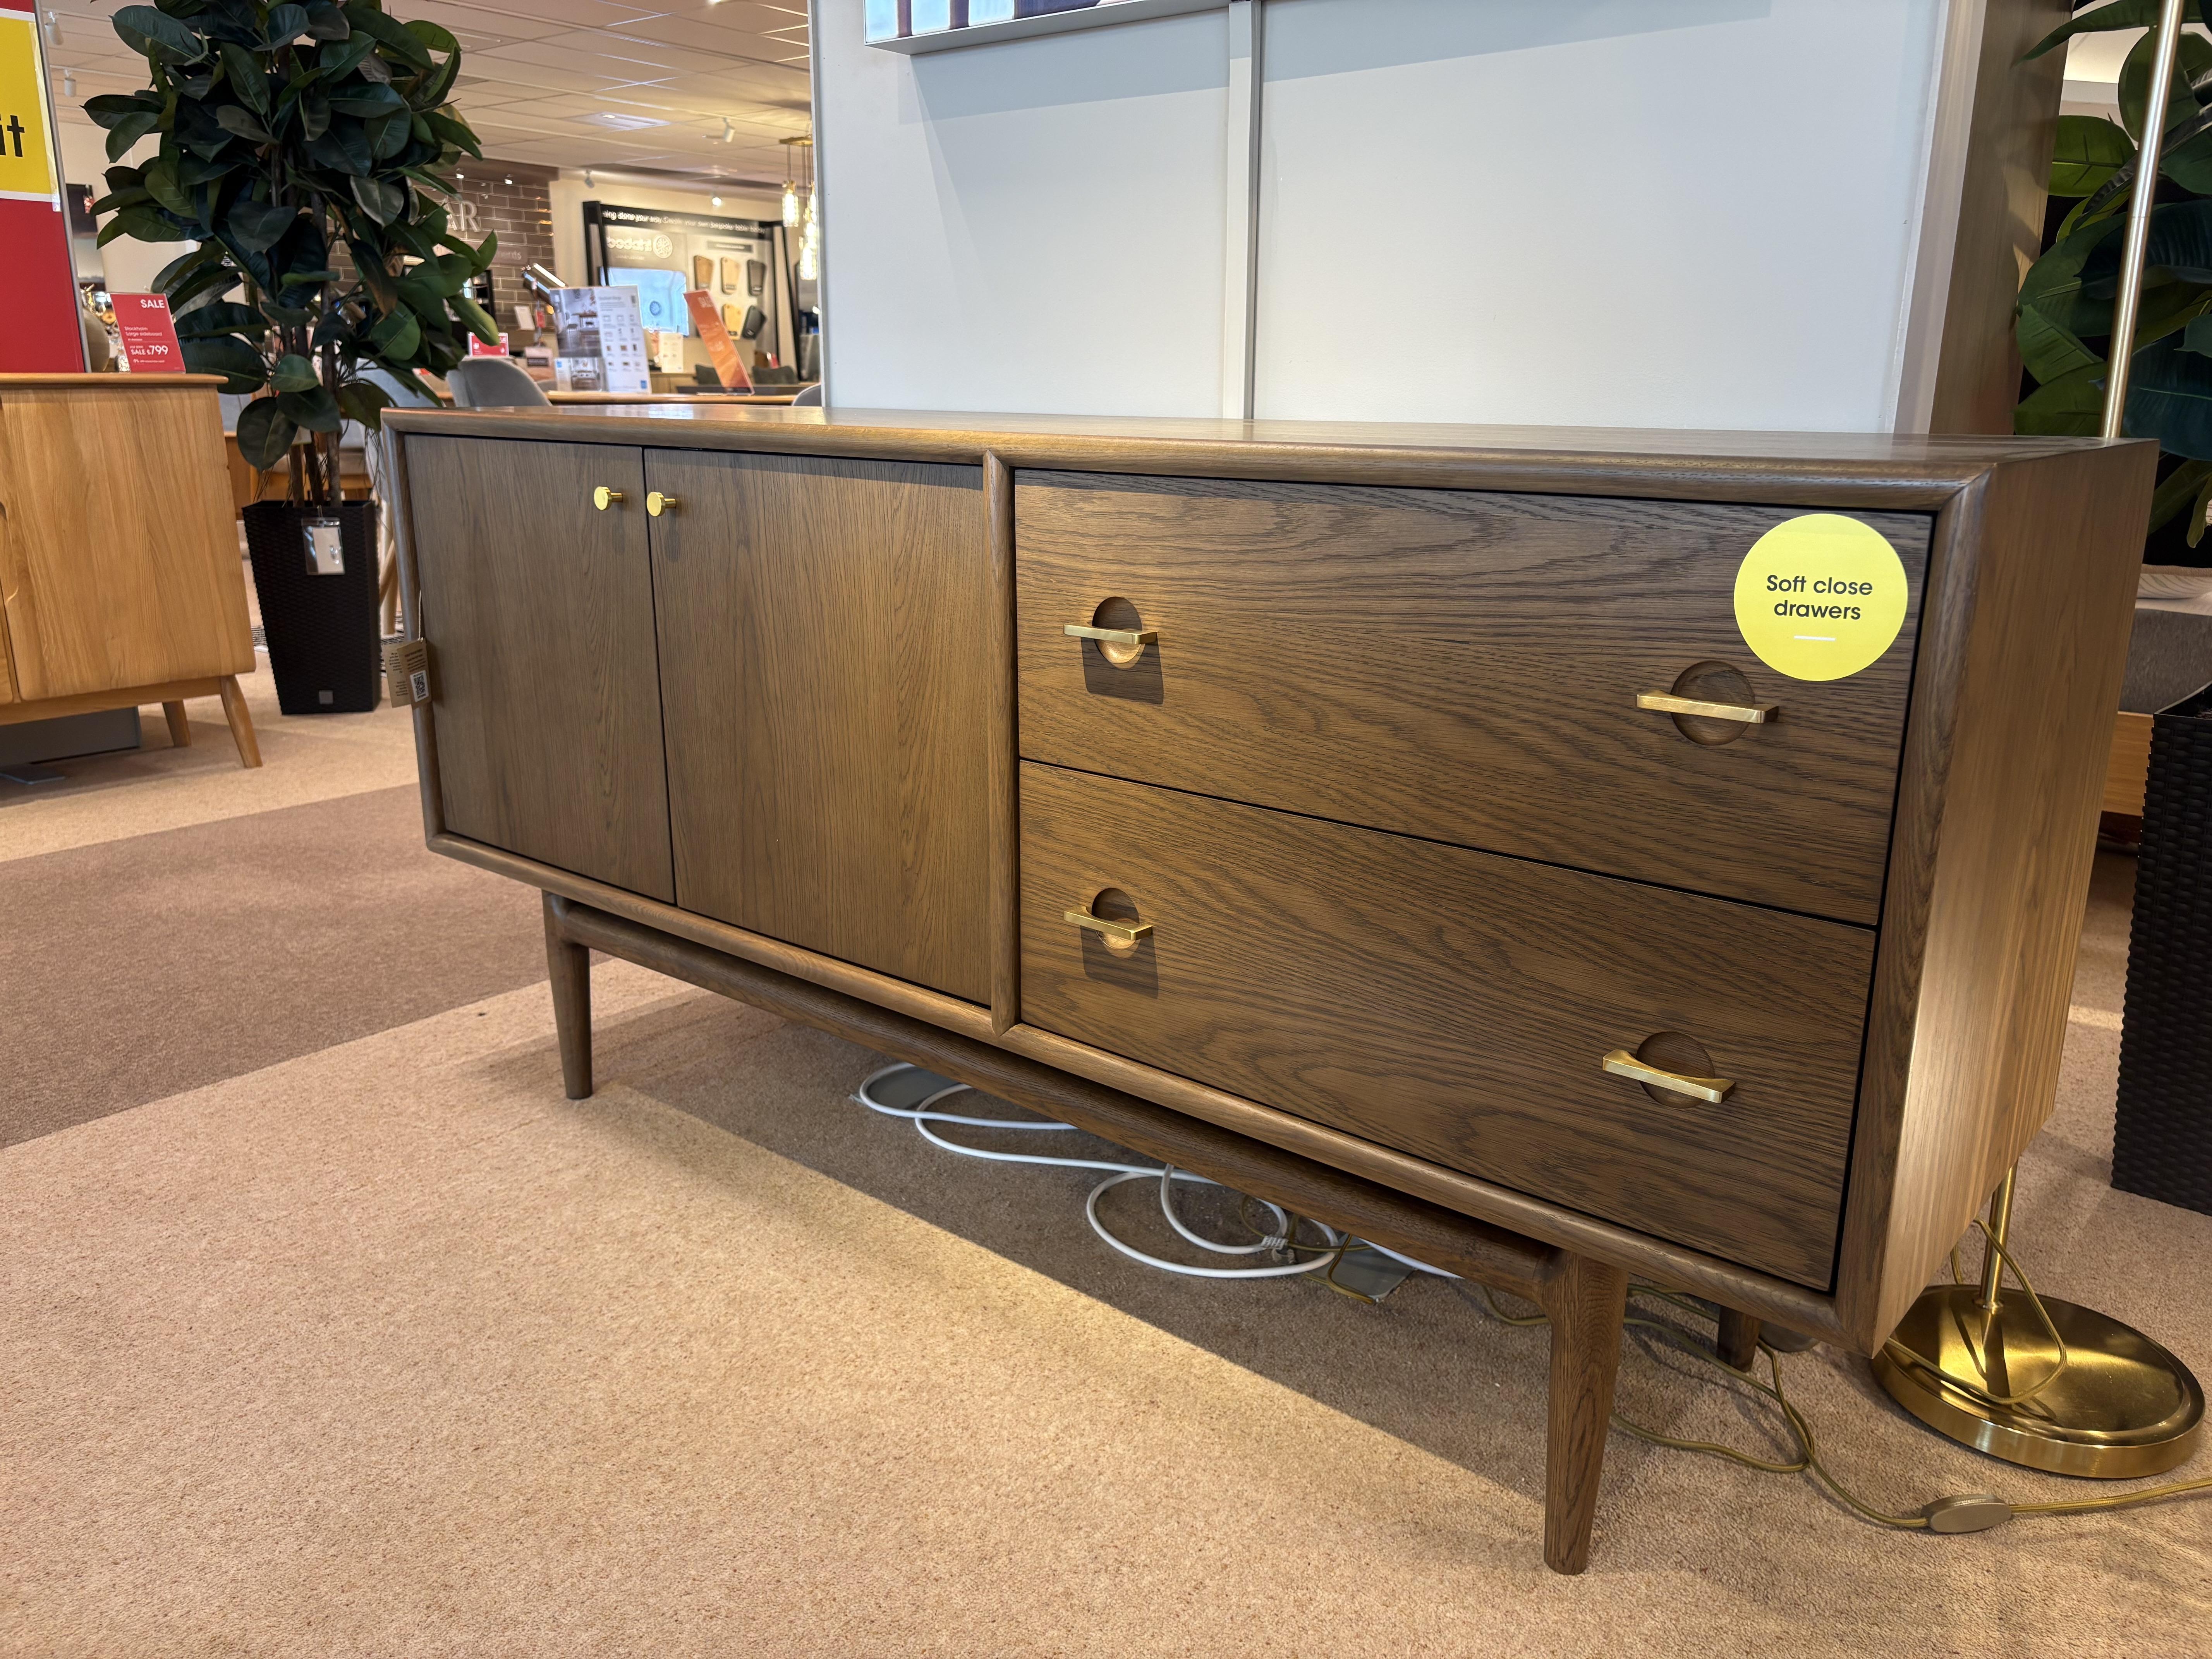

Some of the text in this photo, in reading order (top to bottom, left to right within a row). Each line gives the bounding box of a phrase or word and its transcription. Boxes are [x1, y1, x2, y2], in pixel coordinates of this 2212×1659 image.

[140, 299, 165, 308] SALE
[1766, 574, 1873, 596] Soft close
[1774, 599, 1861, 620] drawers
